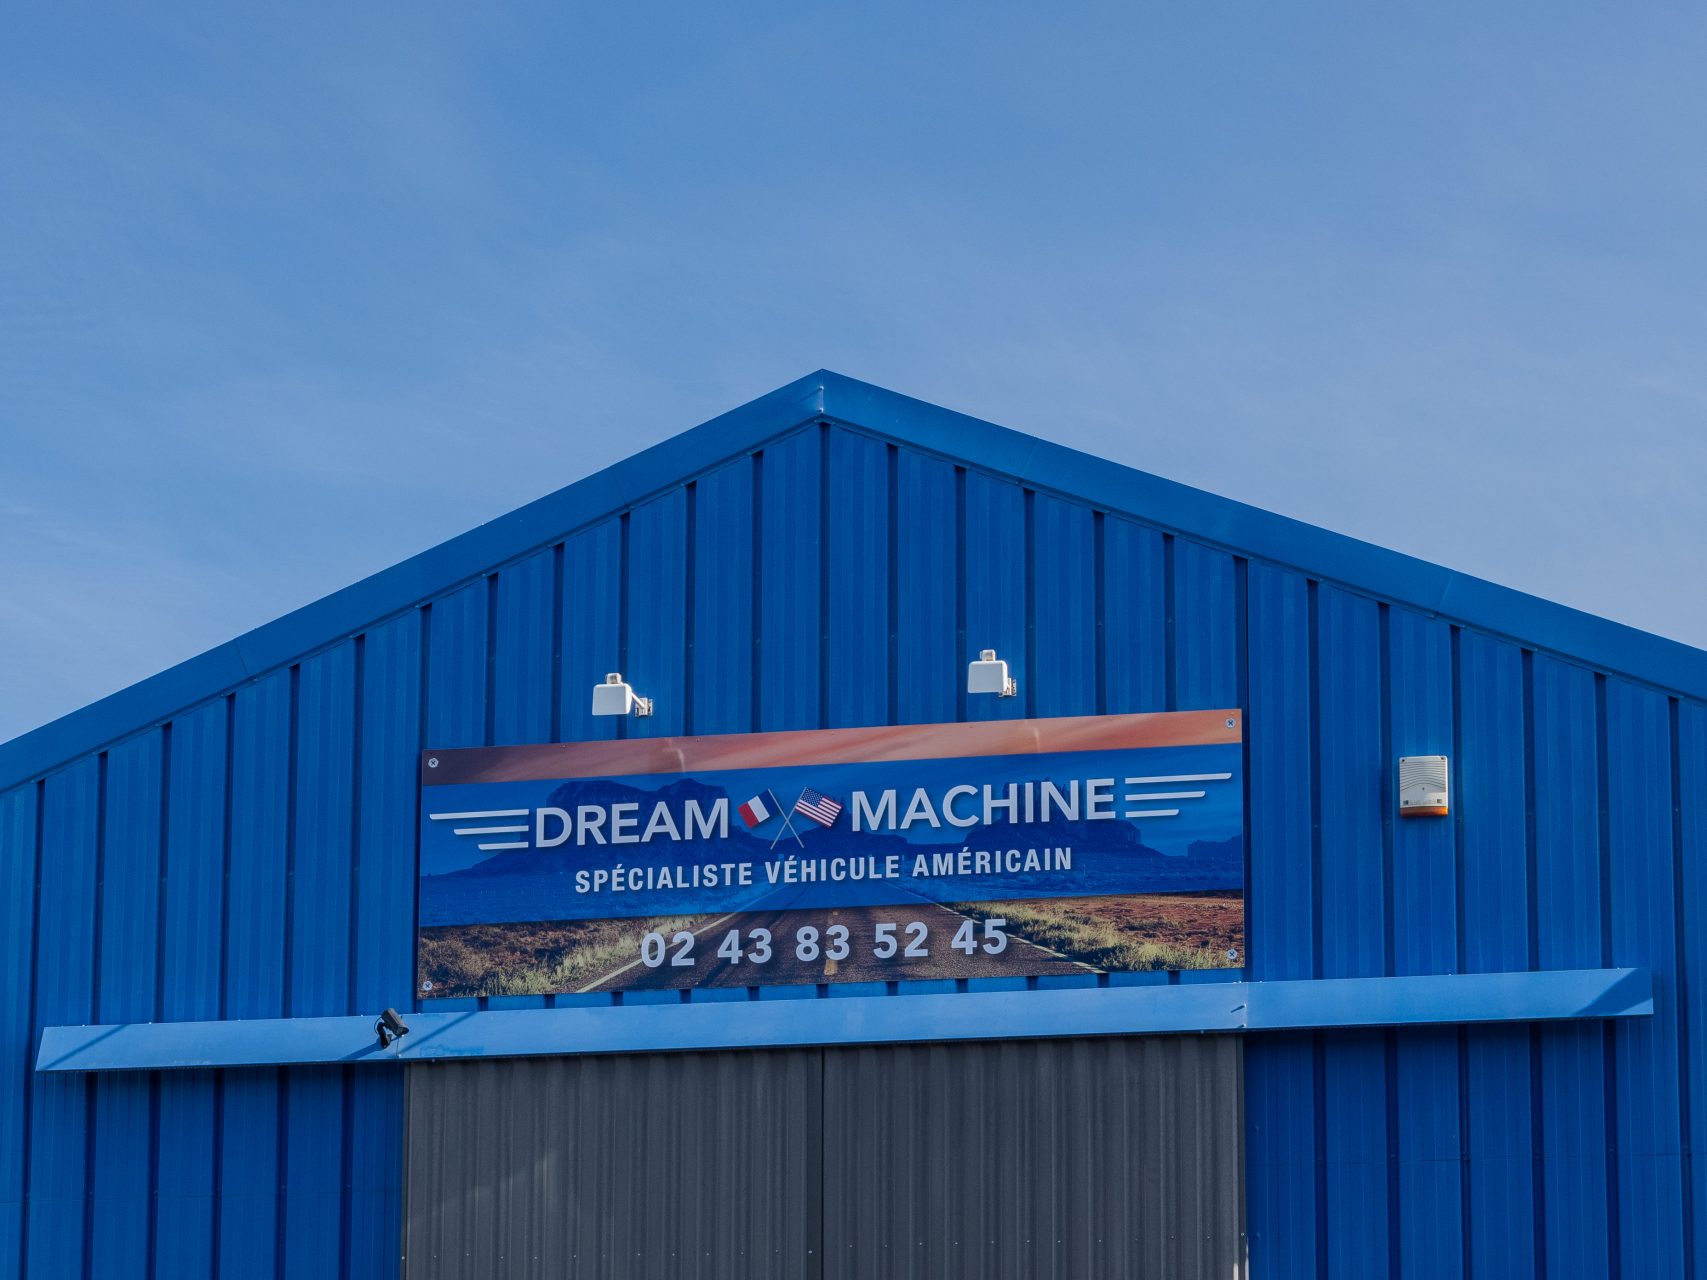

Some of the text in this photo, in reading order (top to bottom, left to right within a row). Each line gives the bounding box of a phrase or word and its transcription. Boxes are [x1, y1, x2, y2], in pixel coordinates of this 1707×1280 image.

[535, 778, 1116, 848] DREAM MACHINE
[575, 847, 1073, 893] SPÉCIALISTE VÉHICULE AMÉRICAIN
[641, 917, 1008, 968] 02 43 83 52 45
